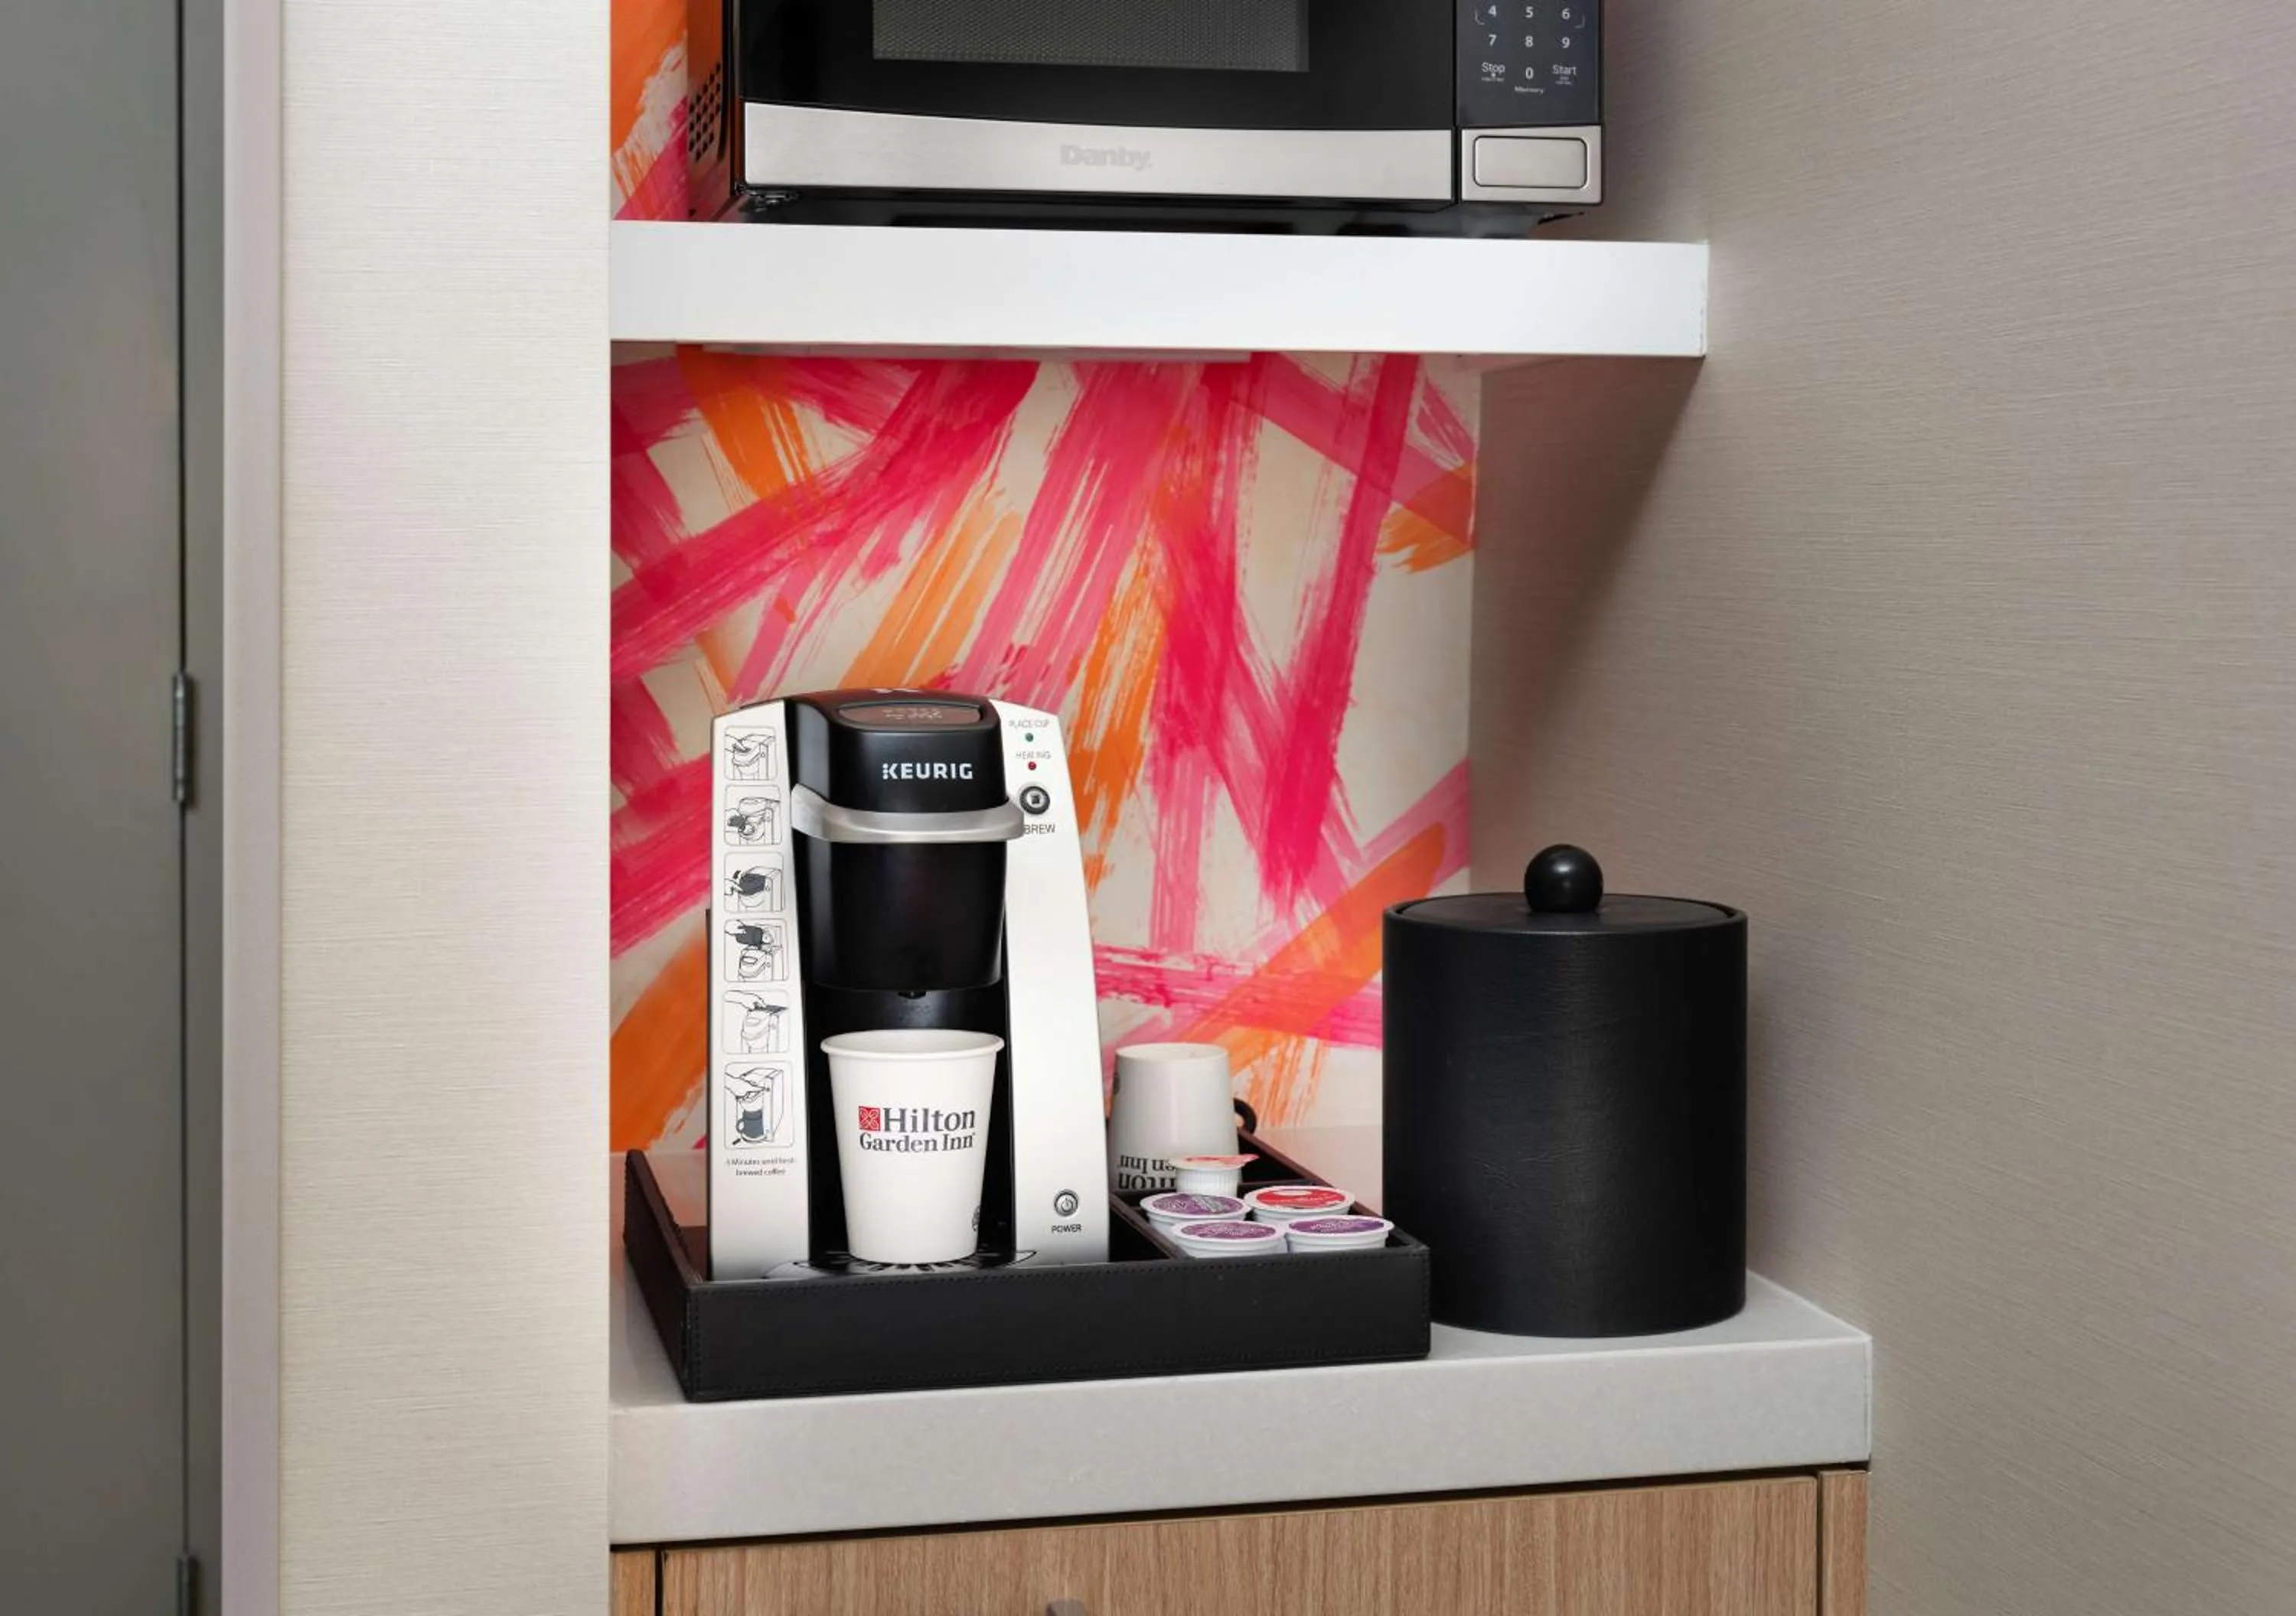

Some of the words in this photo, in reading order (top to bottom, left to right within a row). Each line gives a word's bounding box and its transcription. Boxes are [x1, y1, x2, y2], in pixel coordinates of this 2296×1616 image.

[1488, 5, 1497, 17] 4
[1525, 6, 1534, 18] 5
[1562, 8, 1570, 20] 6
[1488, 34, 1497, 47] 7
[1525, 36, 1534, 47] 8
[1562, 37, 1570, 48] 9
[1482, 62, 1505, 73] Stop
[1525, 67, 1534, 80] 0
[1552, 64, 1577, 76] Start
[1060, 144, 1151, 172] Danby
[882, 763, 974, 780] KEURIG
[1024, 823, 1055, 835] BREW
[883, 1107, 975, 1133] Hilton
[859, 1132, 938, 1153] Garden
[1051, 1223, 1081, 1233] POWER
